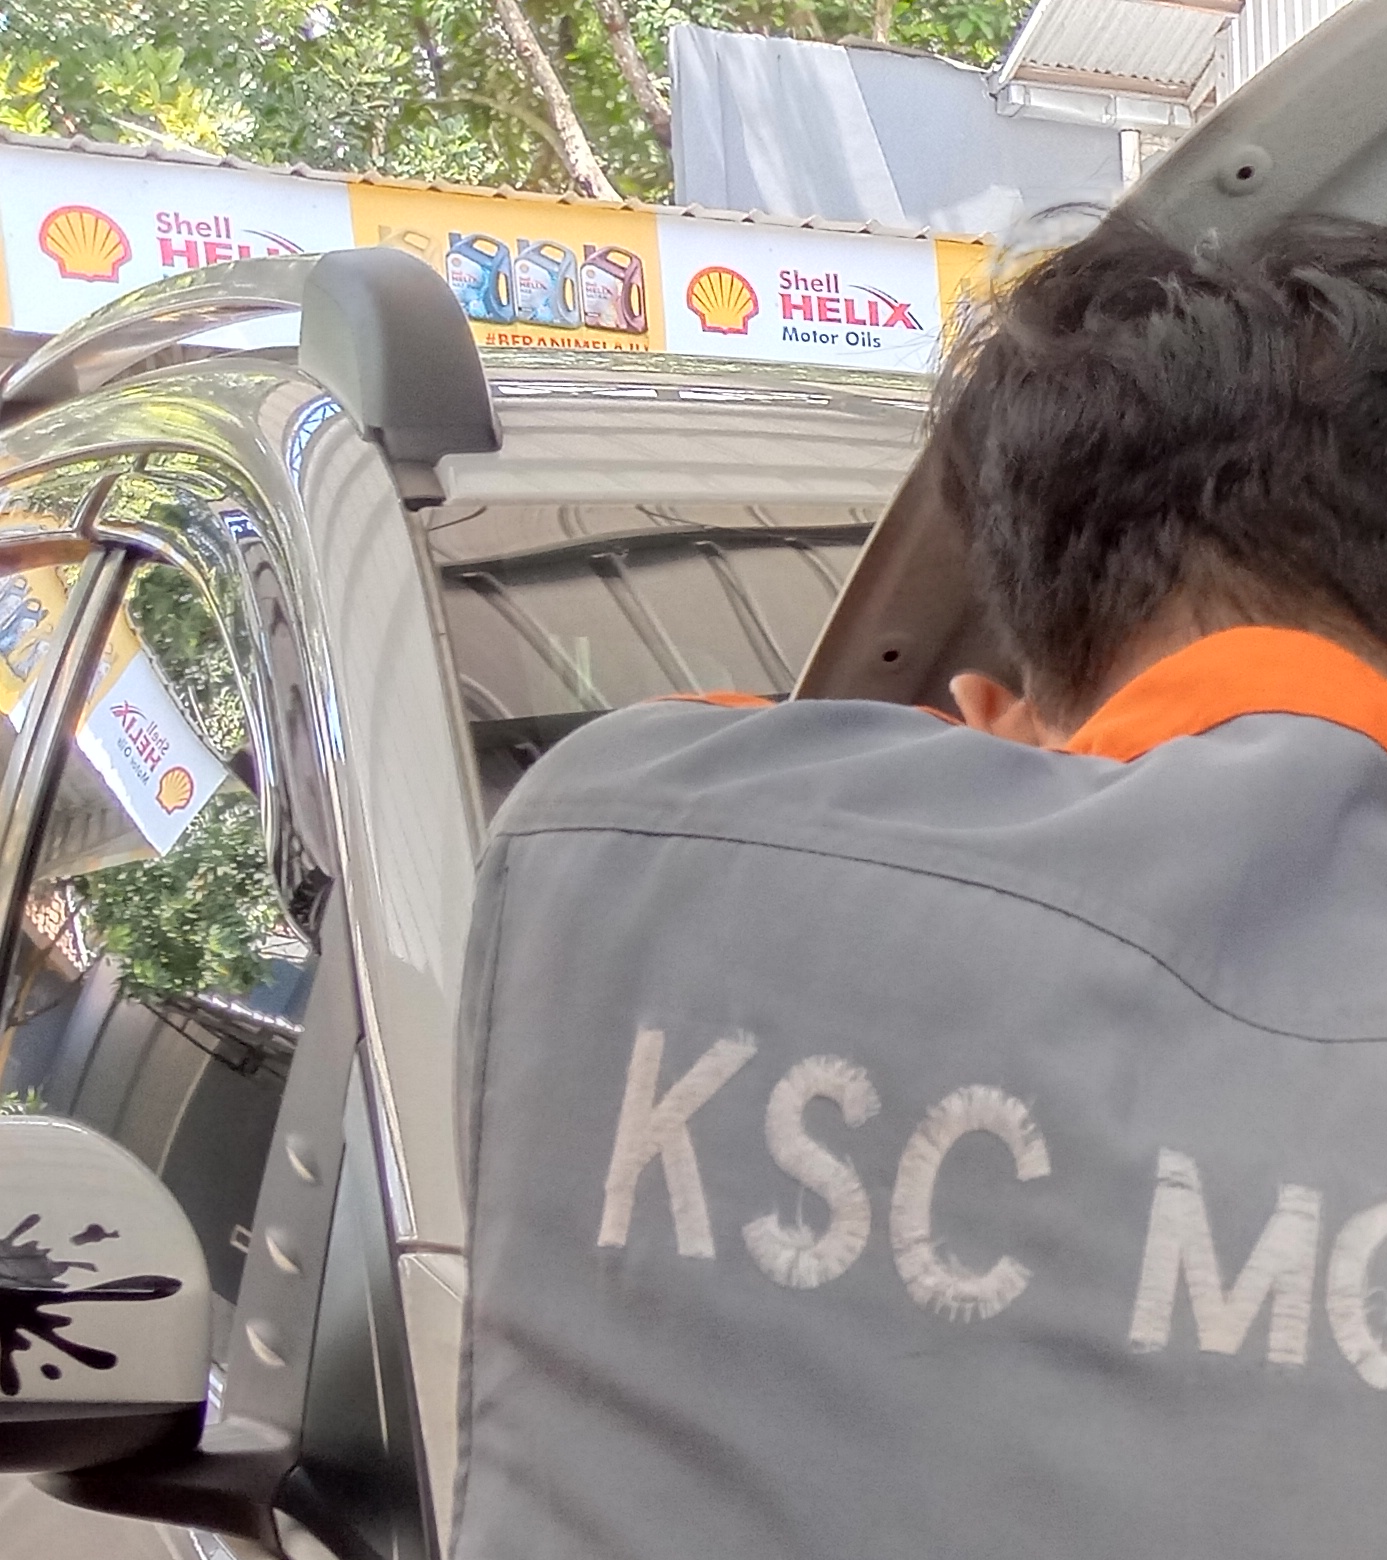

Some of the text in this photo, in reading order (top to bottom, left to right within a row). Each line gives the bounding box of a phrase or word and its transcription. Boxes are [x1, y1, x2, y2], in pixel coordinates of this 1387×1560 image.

[155, 211, 232, 239] Shell
[779, 269, 839, 294] Shell
[779, 292, 919, 330] HELIX
[782, 326, 881, 348] Motor Oils
[596, 1027, 1052, 1323] KSC
